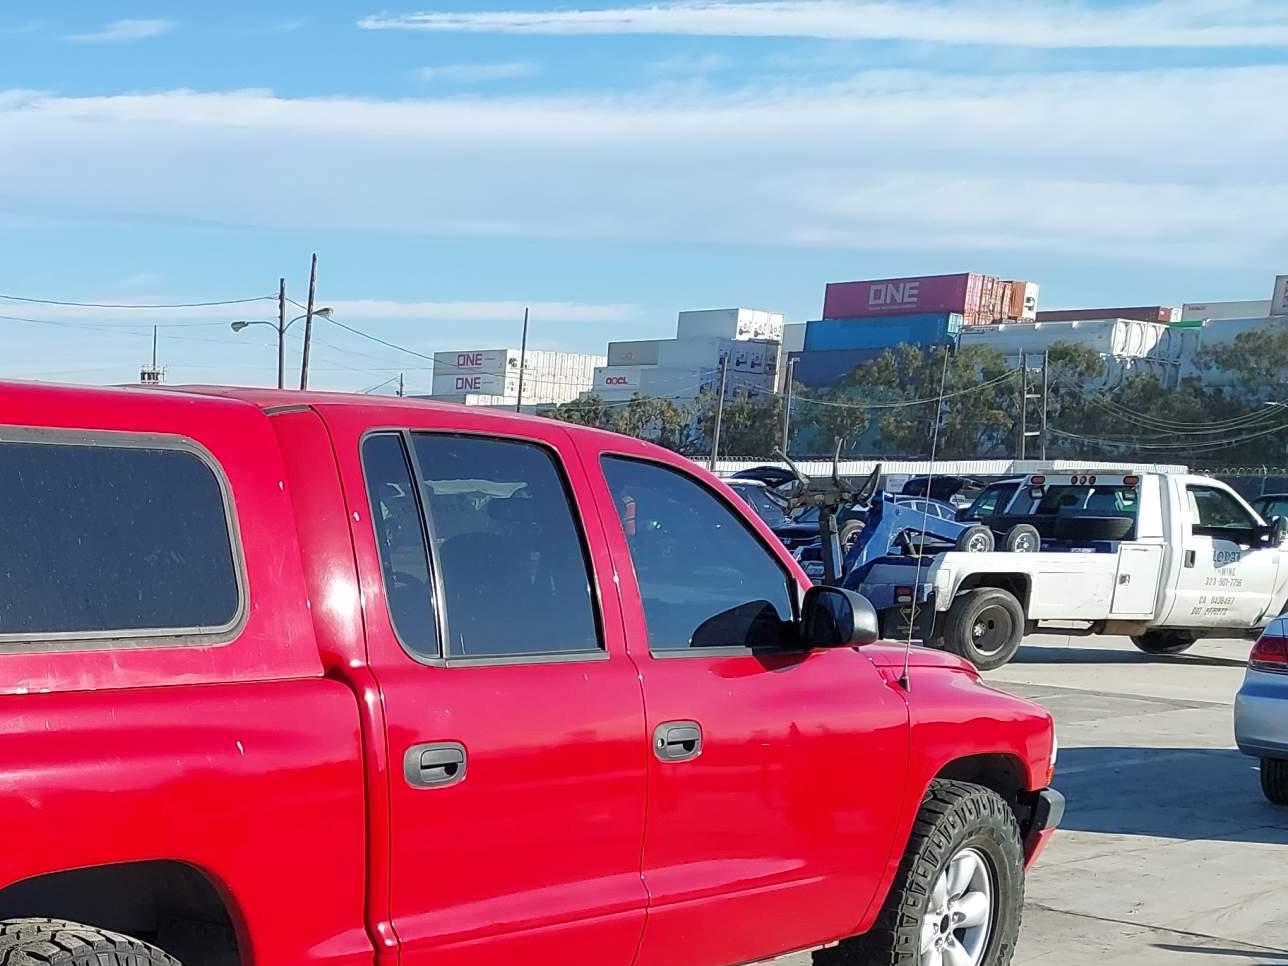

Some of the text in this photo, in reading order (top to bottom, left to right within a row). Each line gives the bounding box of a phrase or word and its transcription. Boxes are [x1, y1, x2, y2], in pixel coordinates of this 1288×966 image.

[869, 282, 920, 305] ONE
[457, 353, 482, 366] ONE
[456, 377, 481, 390] ONE
